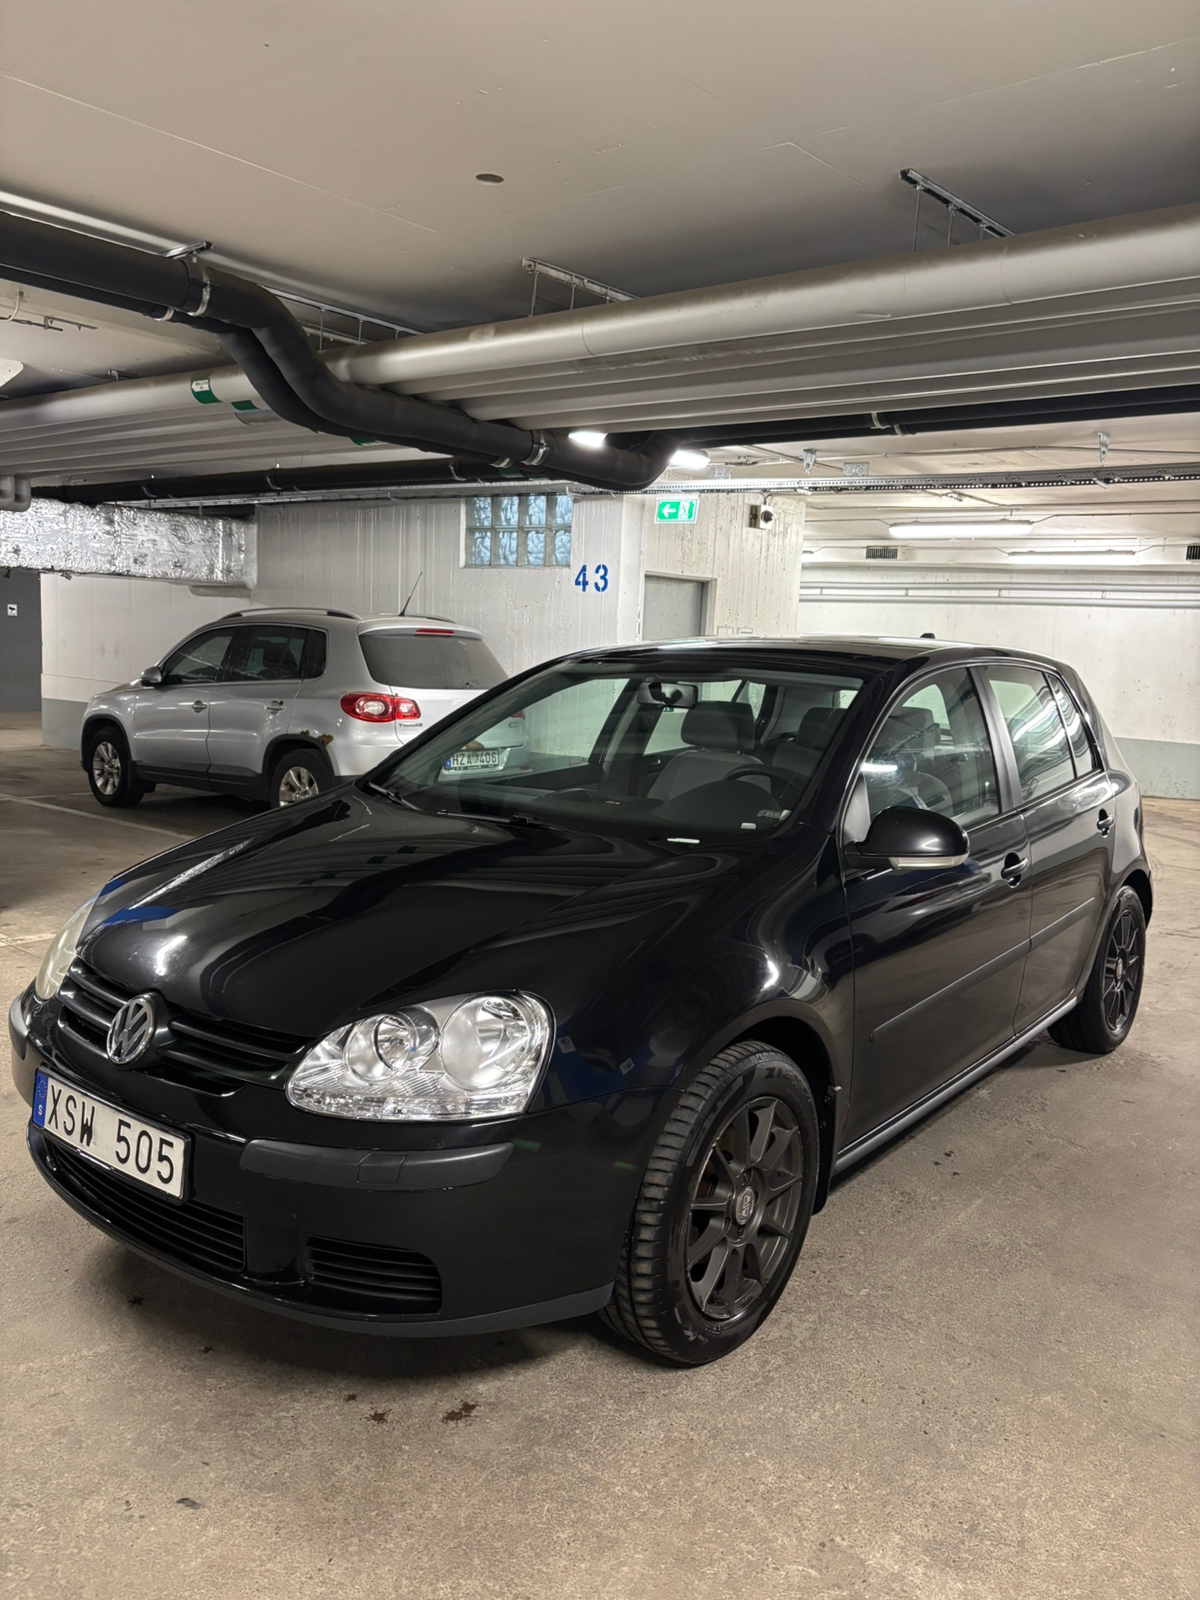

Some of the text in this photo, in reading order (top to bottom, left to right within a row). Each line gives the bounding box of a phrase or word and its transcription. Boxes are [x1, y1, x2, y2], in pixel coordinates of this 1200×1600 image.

[574, 563, 609, 593] 43
[452, 751, 497, 766] HZA 406
[37, 1104, 44, 1116] S
[48, 1084, 175, 1185] XSW 505
